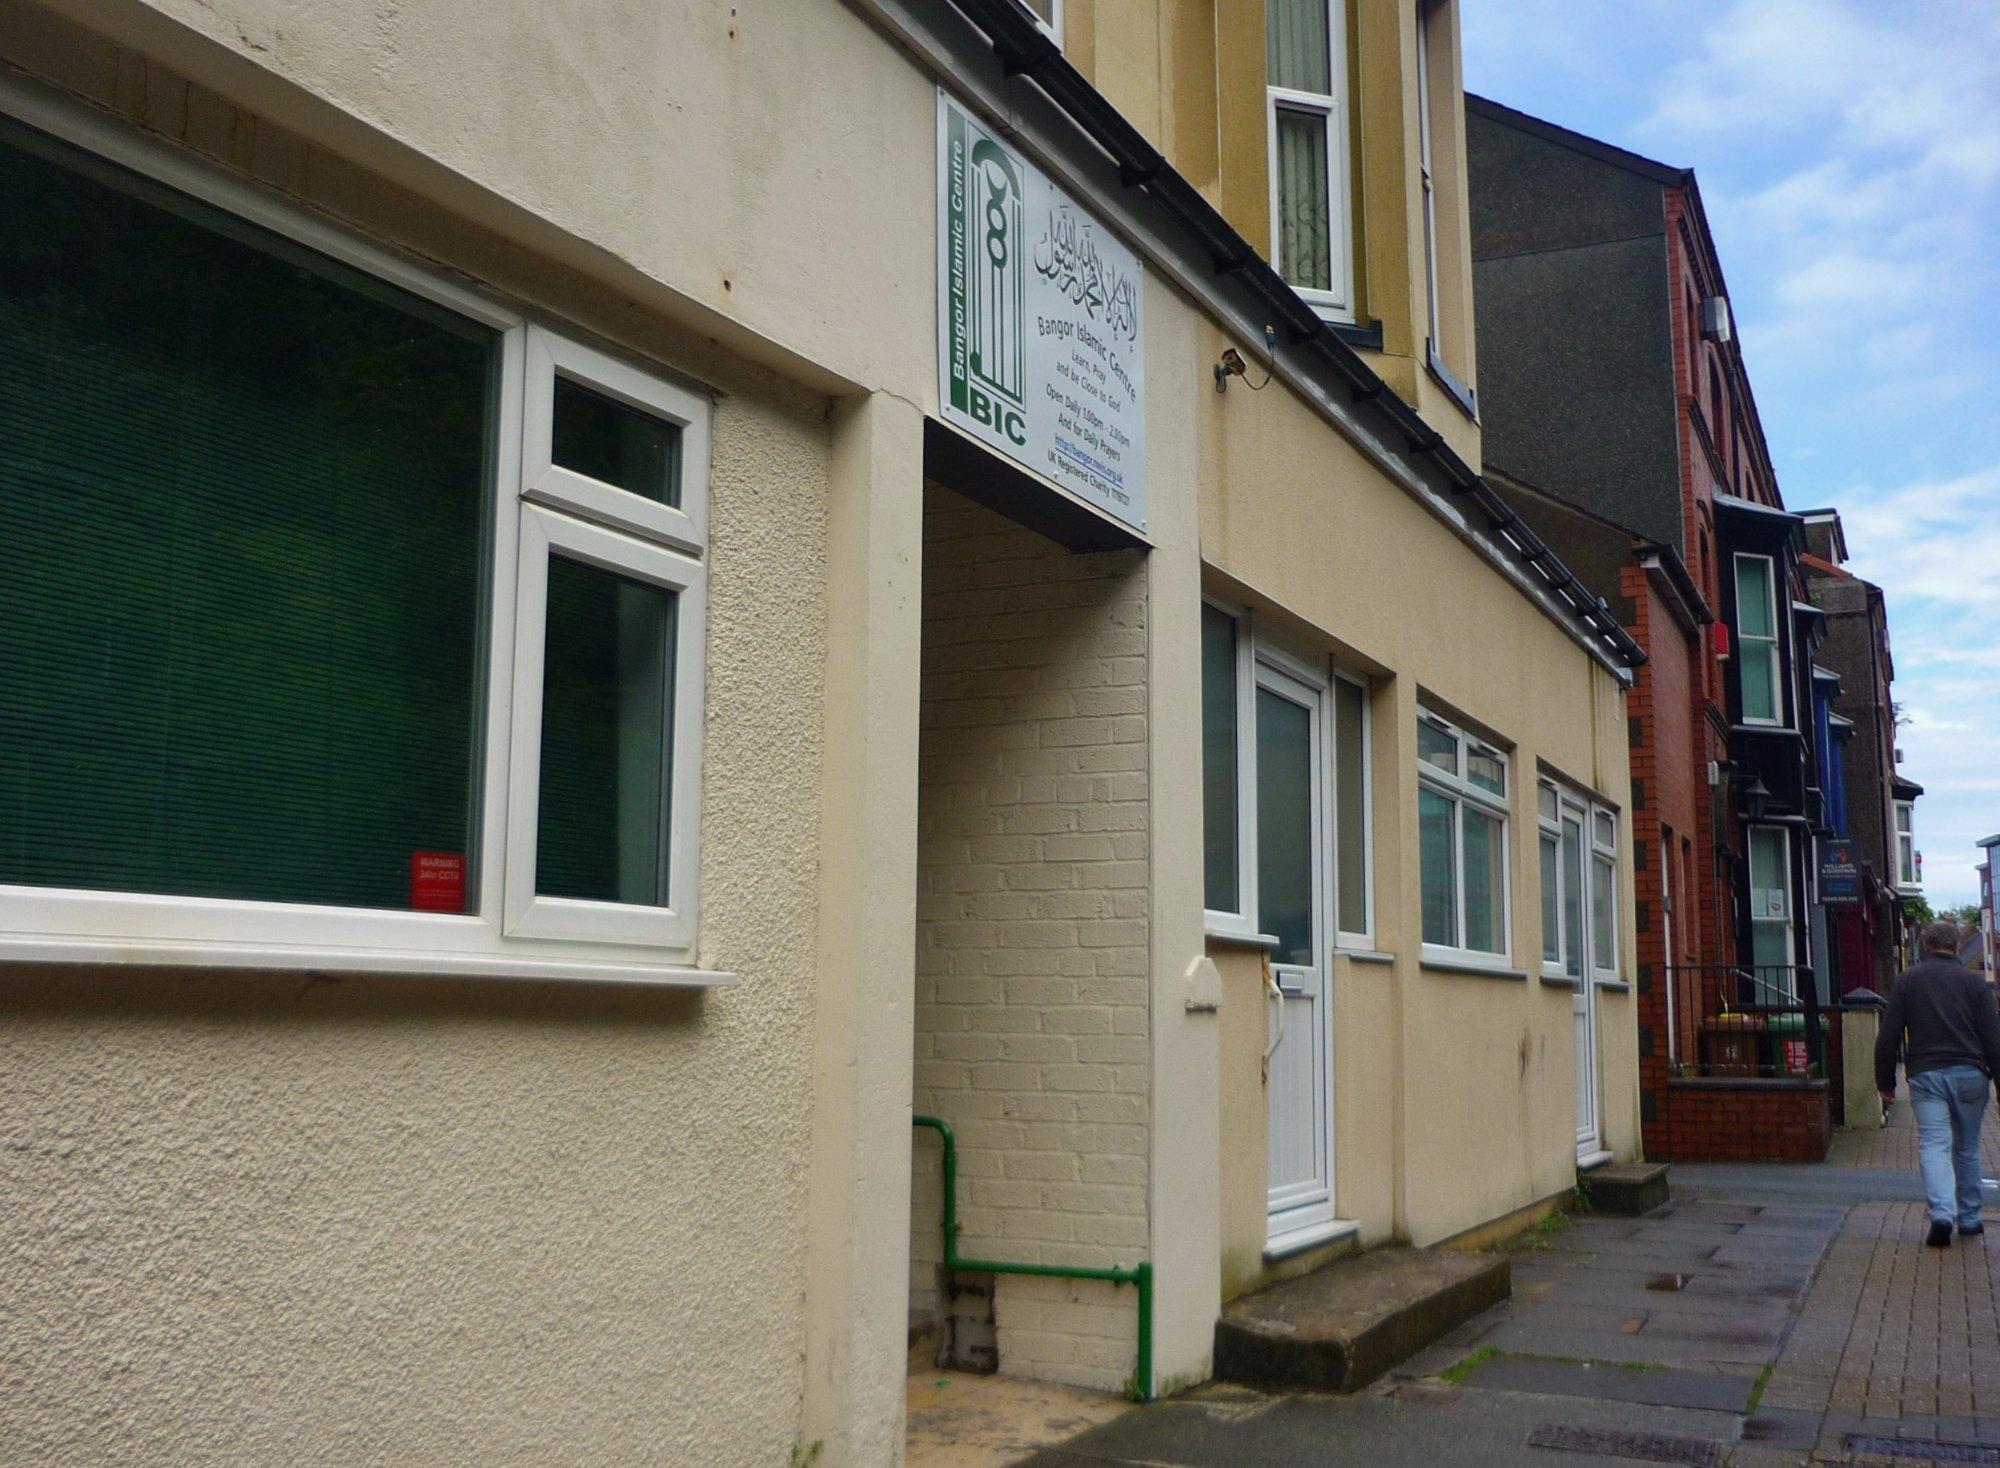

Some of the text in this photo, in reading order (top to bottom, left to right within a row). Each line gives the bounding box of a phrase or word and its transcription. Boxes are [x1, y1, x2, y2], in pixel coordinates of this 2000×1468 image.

[952, 140, 967, 381] Bangor Islamic Centre
[1038, 316, 1136, 403] Bangor Islamic Centre
[1092, 364, 1107, 385] Pray
[1046, 382, 1064, 405] Open
[1065, 395, 1081, 418] Daily
[1056, 361, 1121, 413] and be Close to God
[970, 388, 1027, 447] BIC
[1058, 412, 1121, 462] And for Daily Prayers
[1047, 448, 1057, 465] UK
[1058, 454, 1089, 483] Registered
[1090, 475, 1110, 498] Charity
[420, 857, 460, 868] WARNING
[439, 870, 460, 880] CCTV
